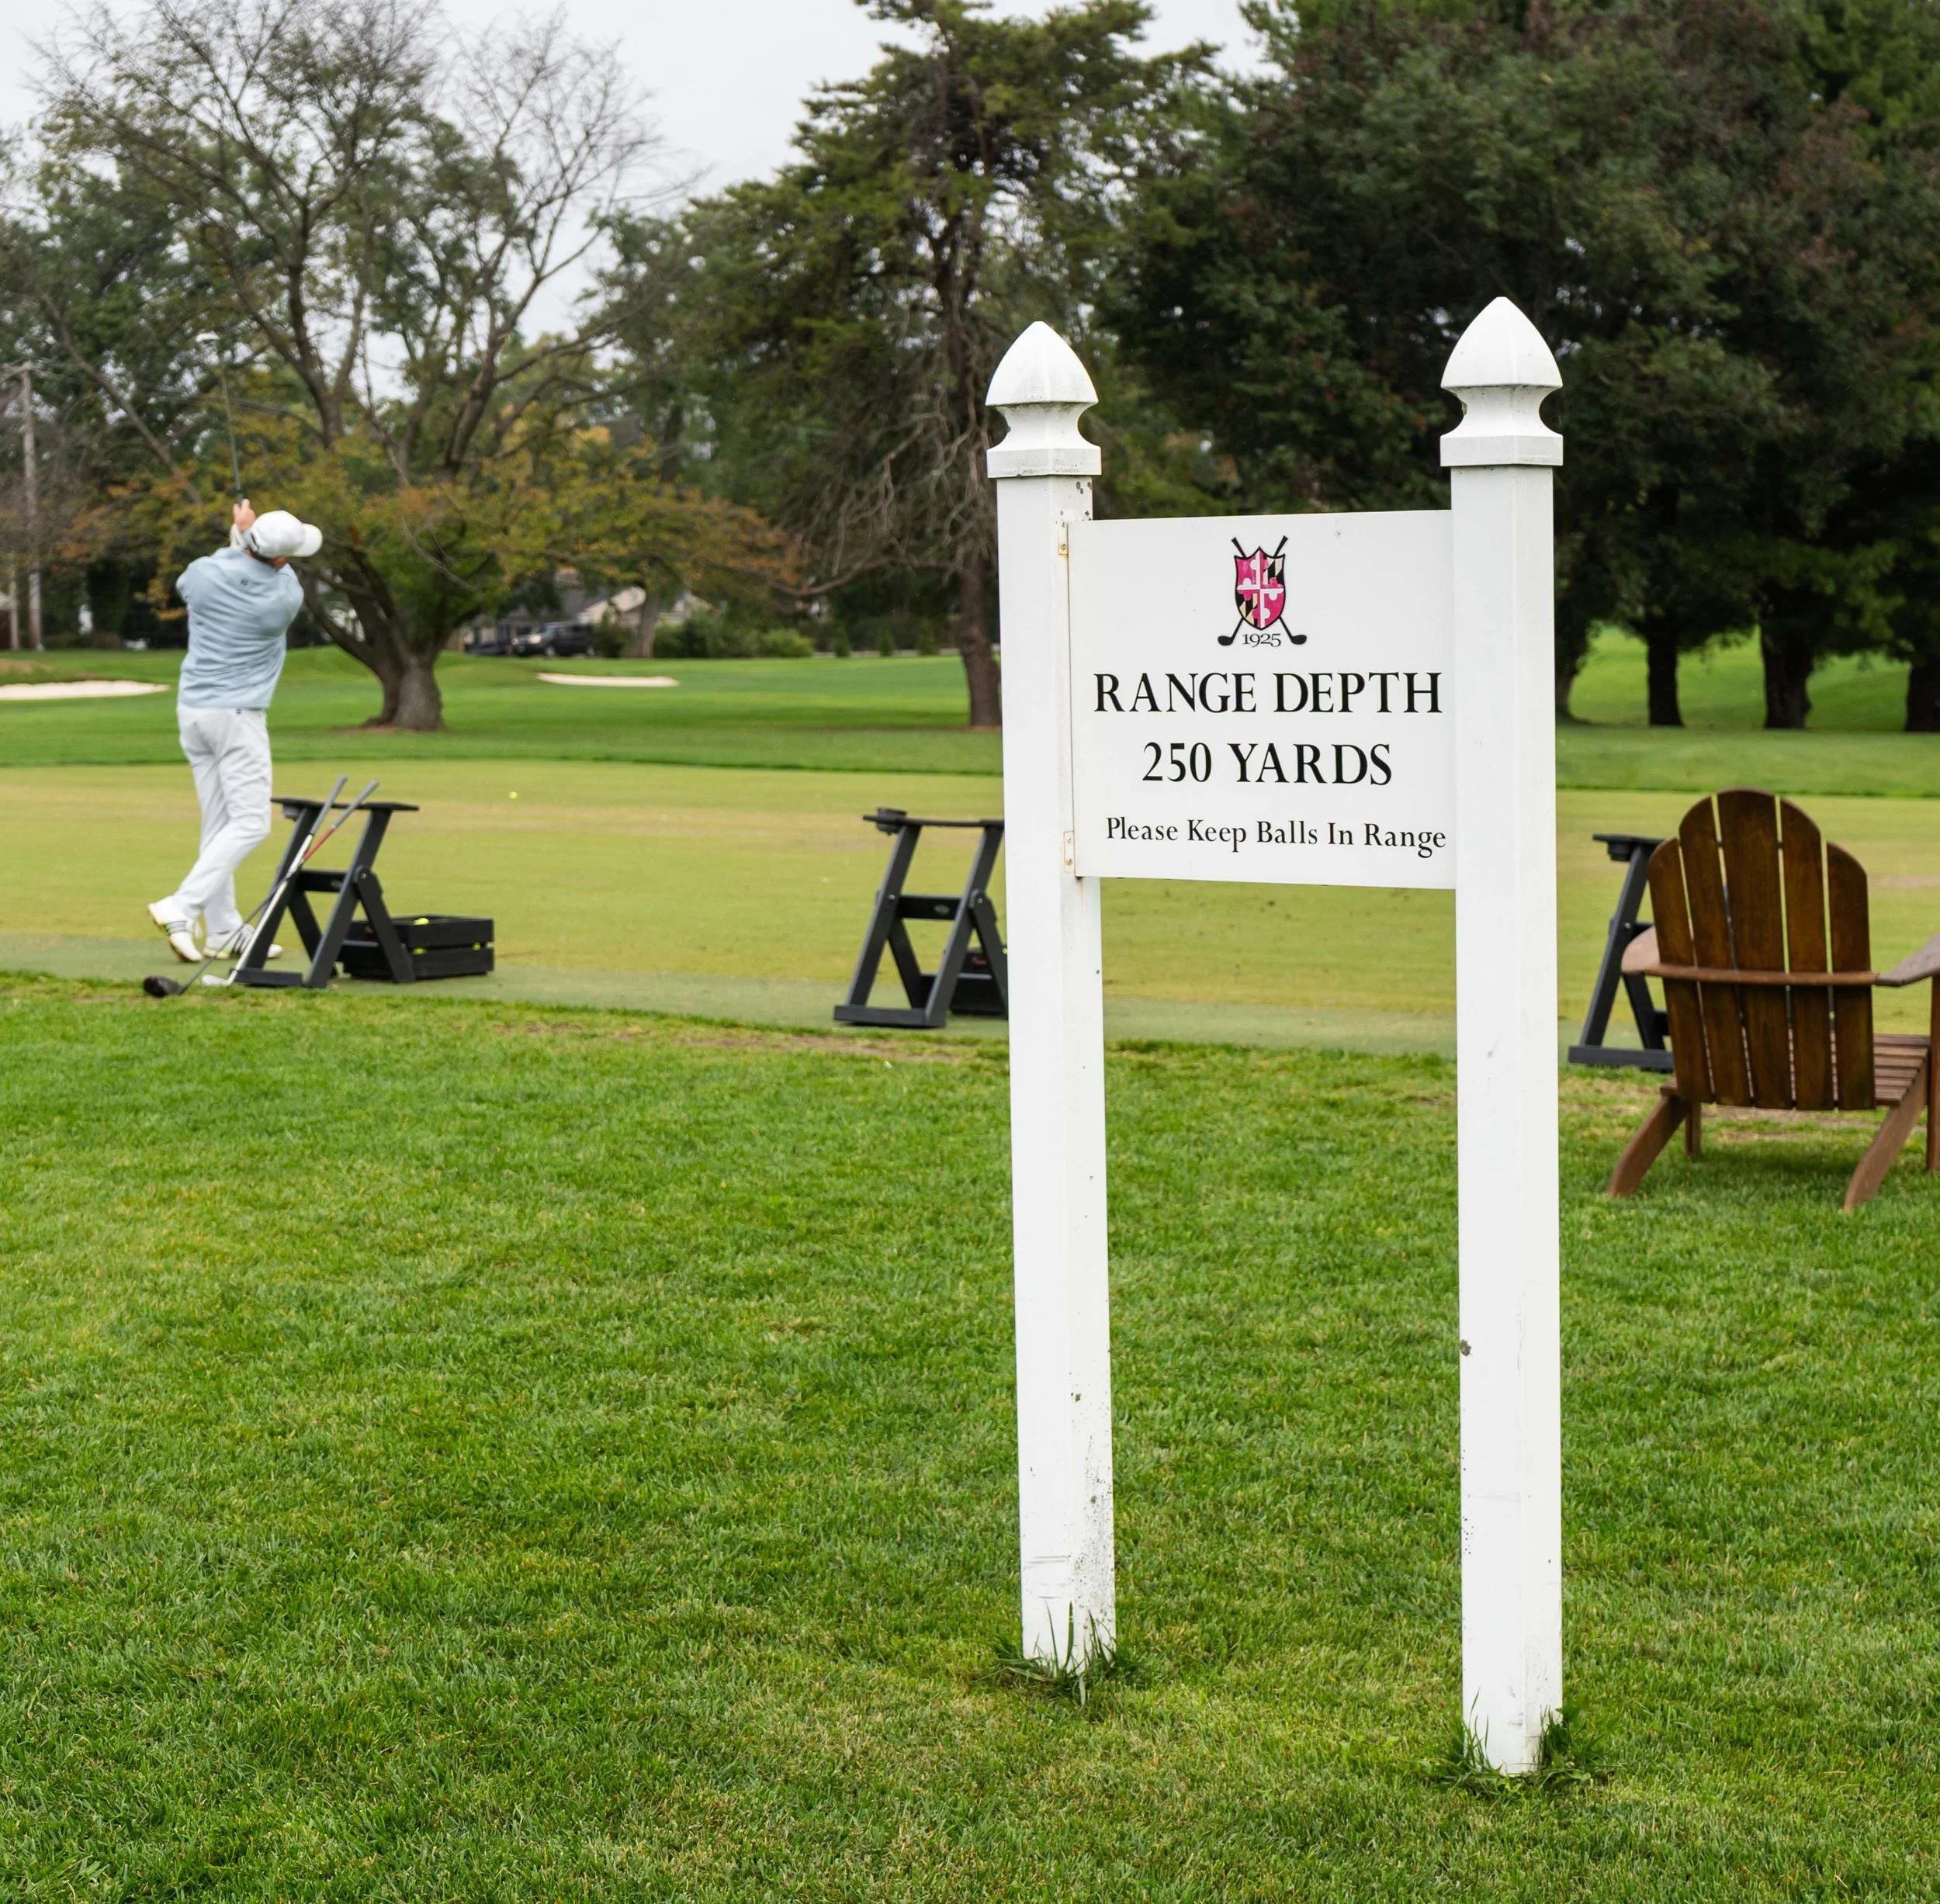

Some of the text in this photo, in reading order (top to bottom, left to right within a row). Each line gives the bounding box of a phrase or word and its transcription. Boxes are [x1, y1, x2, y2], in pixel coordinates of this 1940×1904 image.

[1242, 633, 1281, 647] 1925
[1093, 671, 1443, 714] RANGE DEPTH
[1142, 742, 1392, 786] 250 YARDS
[1107, 817, 1446, 859] Please Keep Balls In Range
